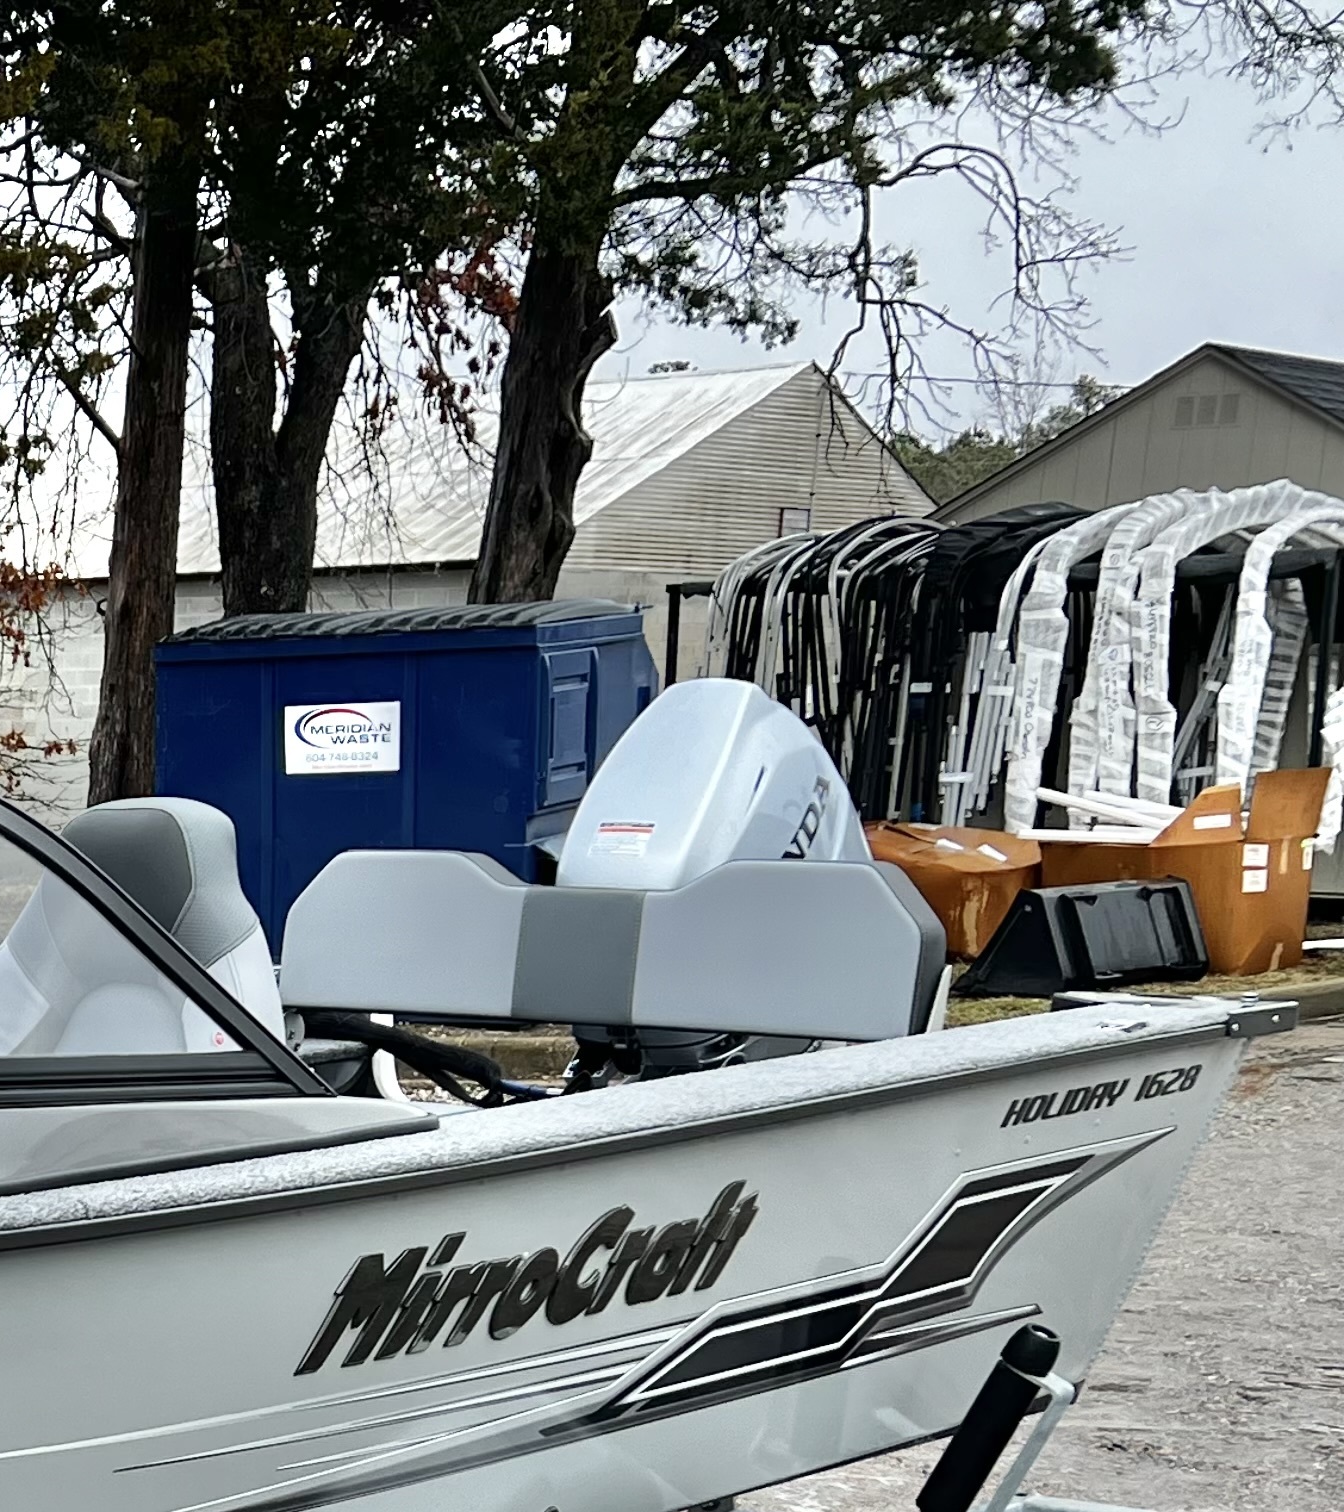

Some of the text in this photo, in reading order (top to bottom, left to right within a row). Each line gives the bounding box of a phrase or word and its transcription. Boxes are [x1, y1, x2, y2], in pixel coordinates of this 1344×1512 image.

[310, 722, 392, 735] MERIDIAN
[330, 733, 392, 745] WASTE
[780, 774, 831, 860] NDA
[999, 1063, 1203, 1128] HOLIDAY 1628
[292, 1178, 760, 1376] MirroCraft
